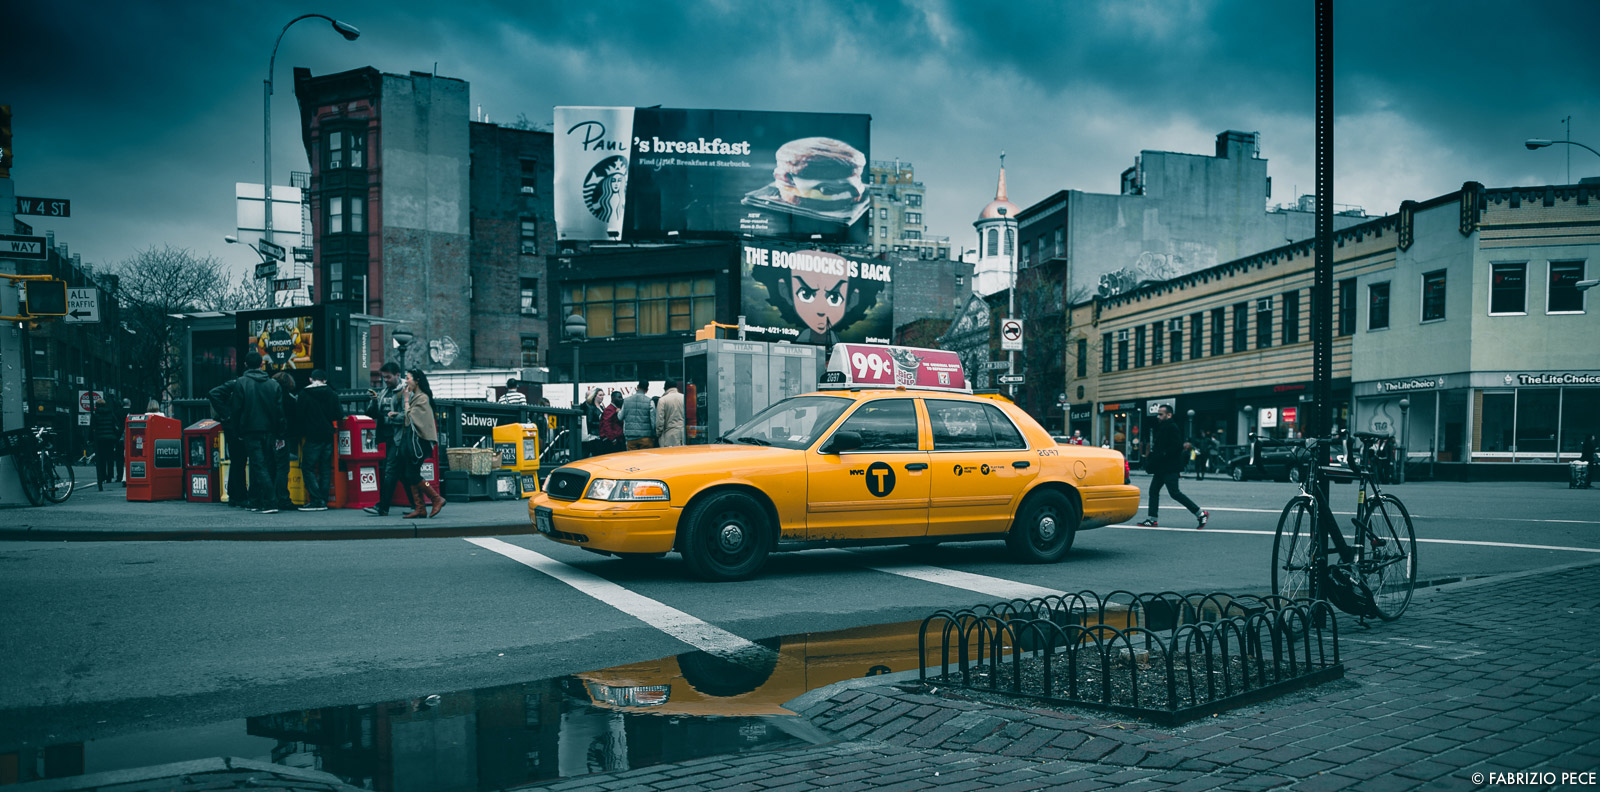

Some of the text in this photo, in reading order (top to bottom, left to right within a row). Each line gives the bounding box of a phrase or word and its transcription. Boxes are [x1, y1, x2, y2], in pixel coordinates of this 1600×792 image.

[567, 121, 627, 151] PAUL
[652, 137, 751, 155] breakfast
[677, 159, 708, 167] Breakfast
[20, 201, 66, 216] W 4 ST
[11, 242, 36, 252] WAY
[744, 246, 892, 282] THE BOONDOCKS IS BACK
[70, 290, 90, 299] ALL
[745, 325, 765, 334] Monday
[461, 413, 498, 427] Subway
[1071, 411, 1080, 419] fat
[339, 436, 350, 447] GO
[157, 447, 179, 455] metro
[192, 476, 208, 490] am
[361, 472, 375, 484] GO
[872, 469, 889, 493] T
